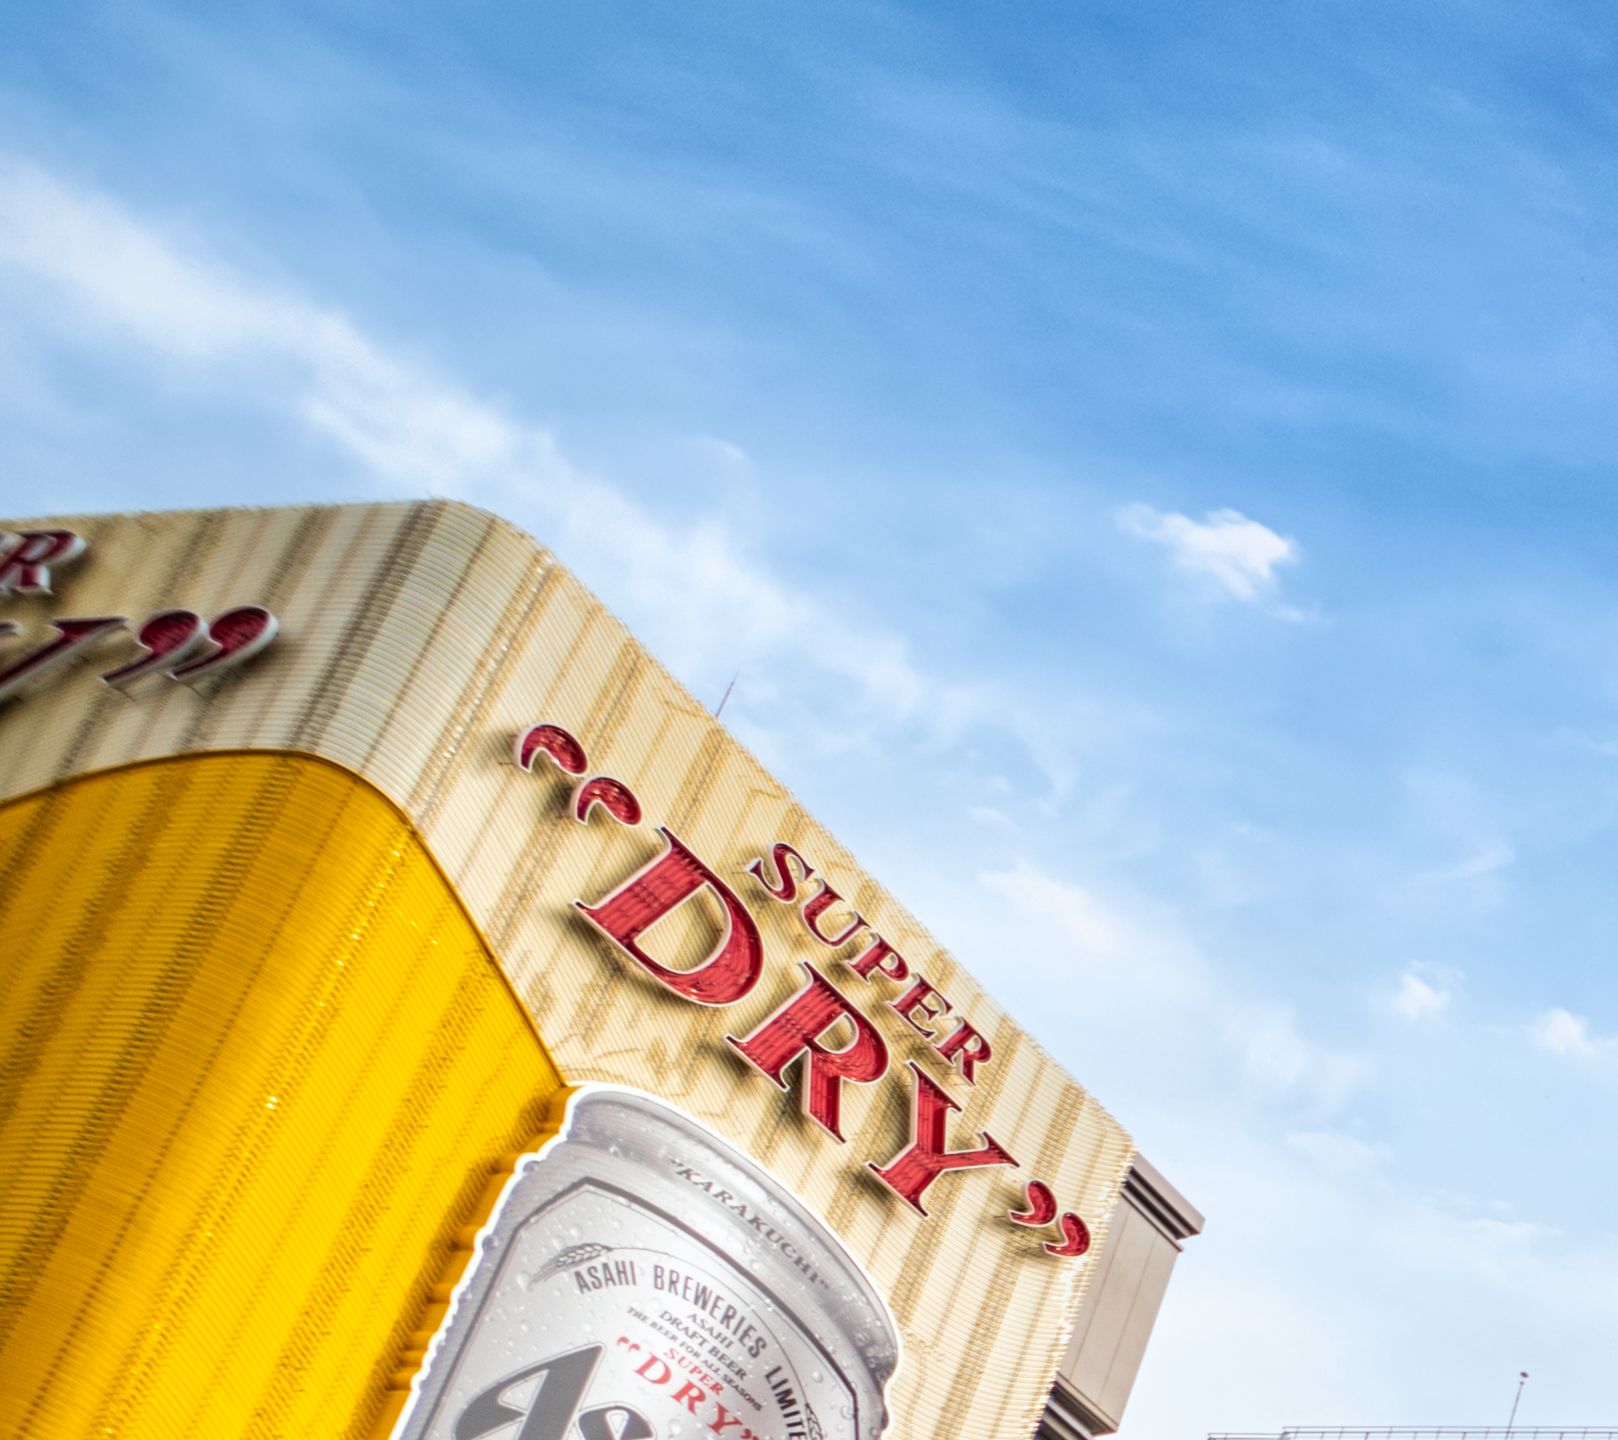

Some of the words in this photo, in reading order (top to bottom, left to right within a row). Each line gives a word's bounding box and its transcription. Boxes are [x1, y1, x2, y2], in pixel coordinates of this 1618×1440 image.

[747, 842, 992, 1085] SUPER
[575, 1261, 638, 1294] ASAHI
[653, 1264, 768, 1359] BREWERIES
[659, 1310, 706, 1347] DRAFT
[708, 1345, 748, 1381] BEER
[686, 1311, 733, 1350] ASAHI
[663, 1347, 724, 1396] SUPER
